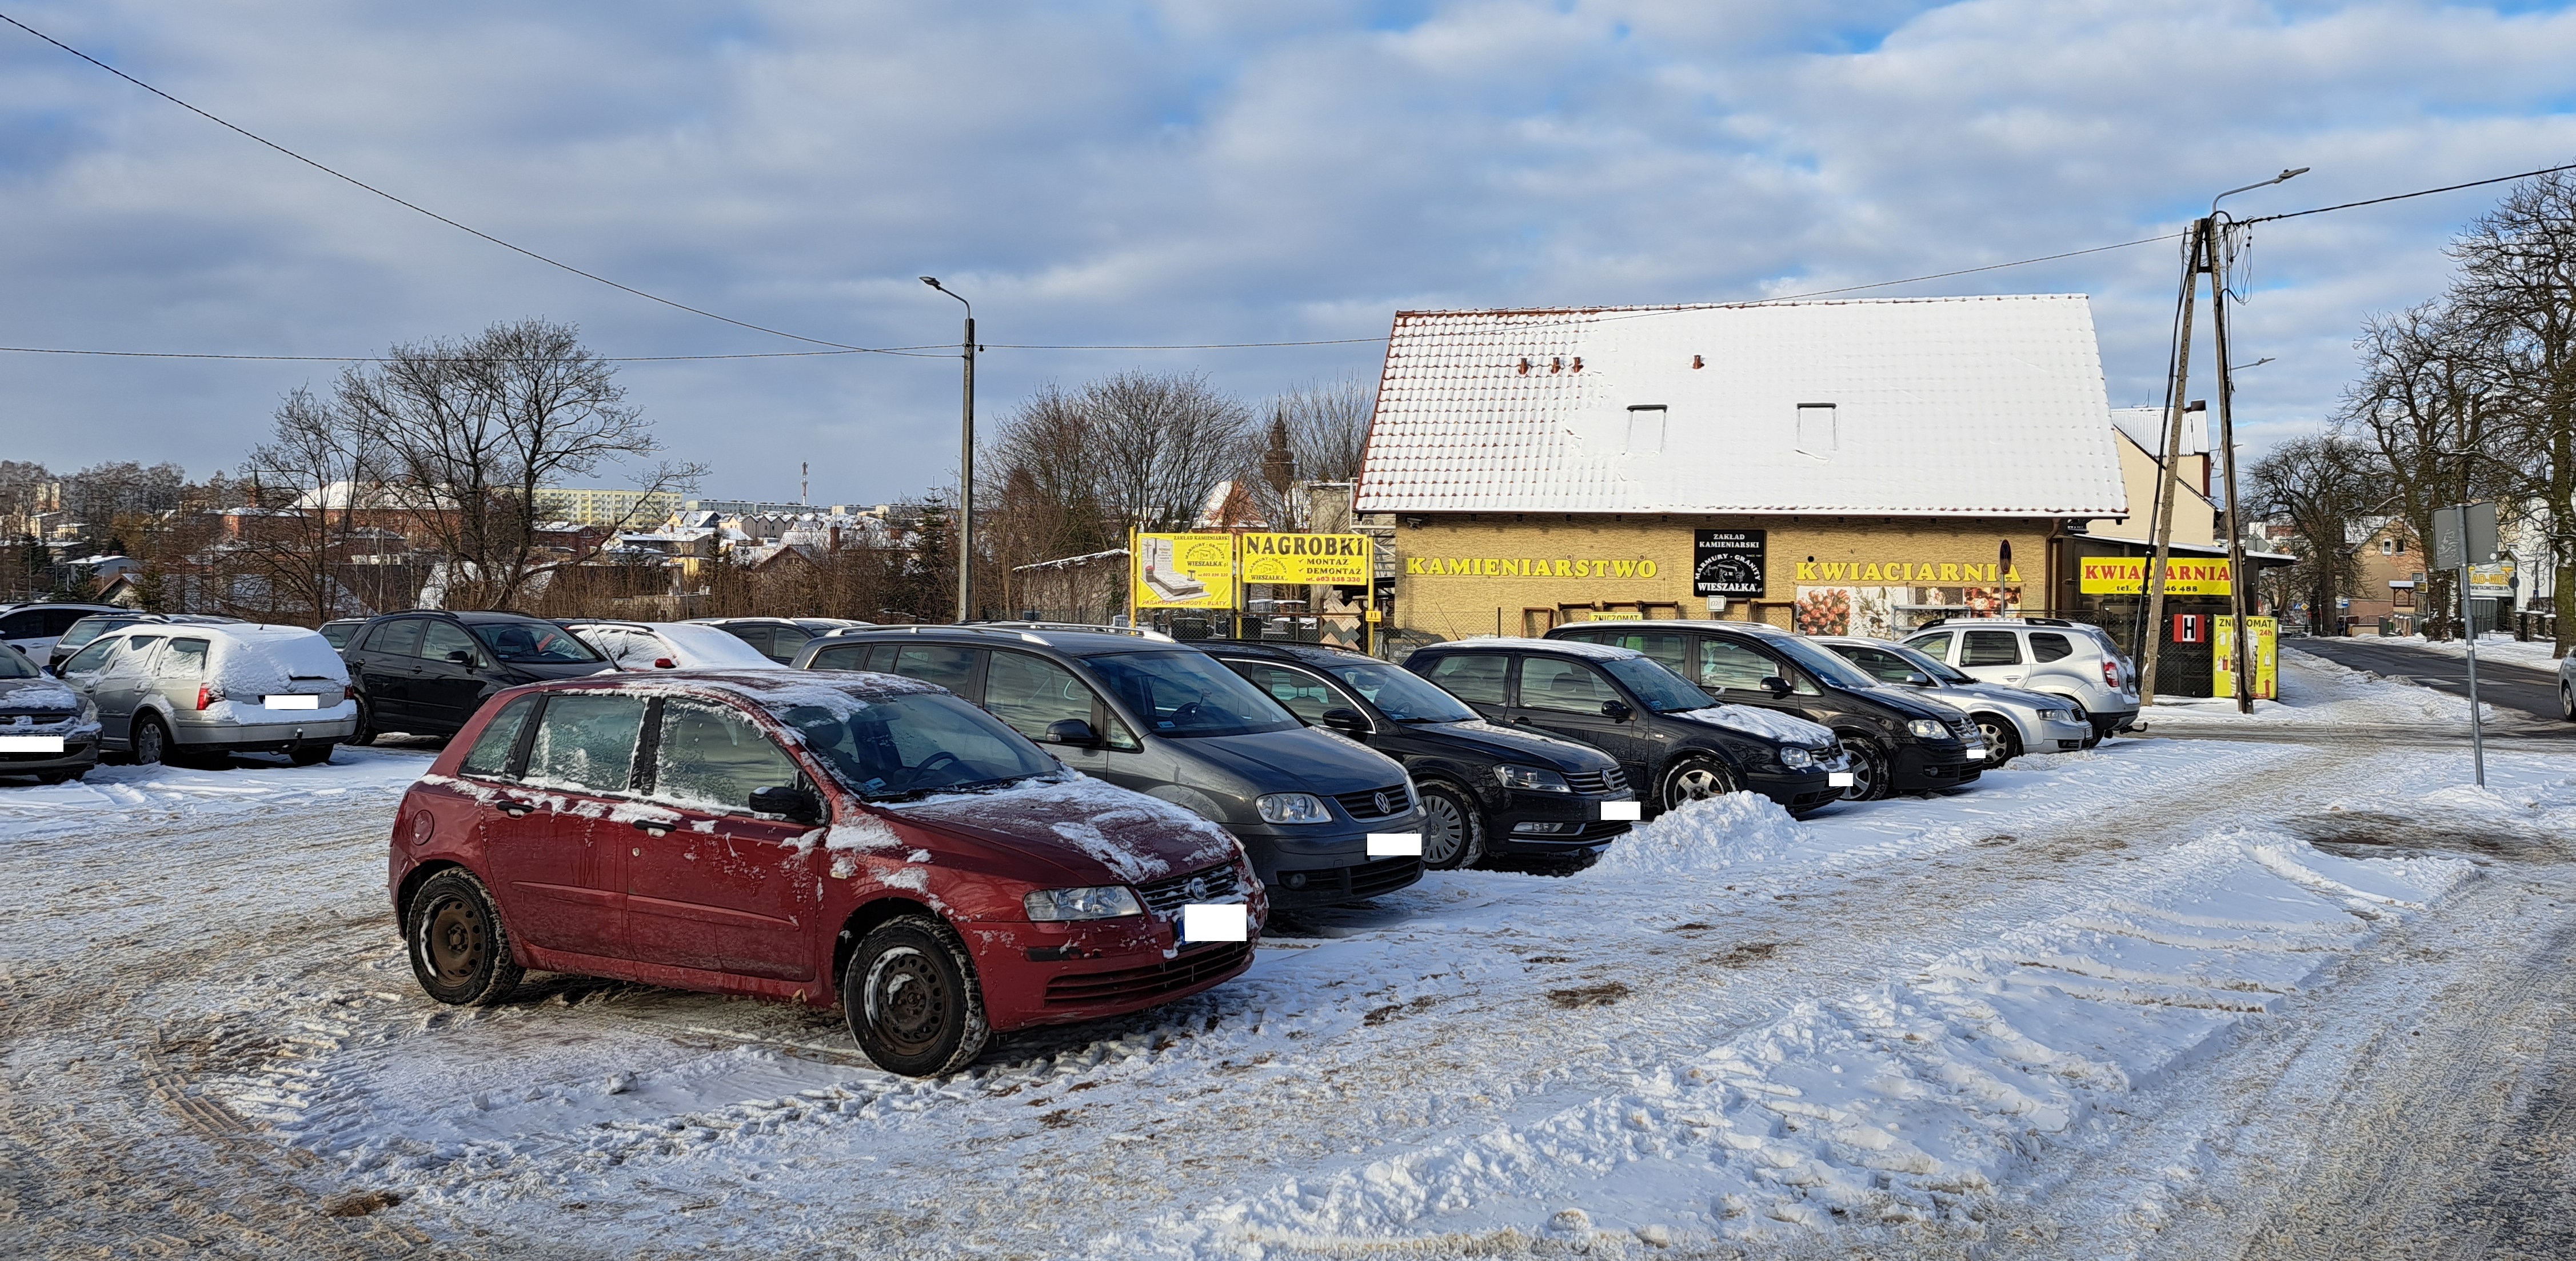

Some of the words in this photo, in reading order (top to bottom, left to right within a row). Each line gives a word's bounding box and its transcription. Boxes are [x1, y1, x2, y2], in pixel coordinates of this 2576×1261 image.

[1246, 536, 1364, 556] NAGROBKI
[1307, 566, 1362, 575] DEMONTAŻ
[1406, 557, 1658, 578] KAMIENIARSTWO
[1695, 554, 1728, 580] MARMURY
[1734, 554, 1762, 581] GRANITY
[1794, 562, 2023, 582] KWIACIARNIA
[2084, 565, 2230, 581] KWIACARNIA
[2219, 619, 2273, 628] ZNOMAT
